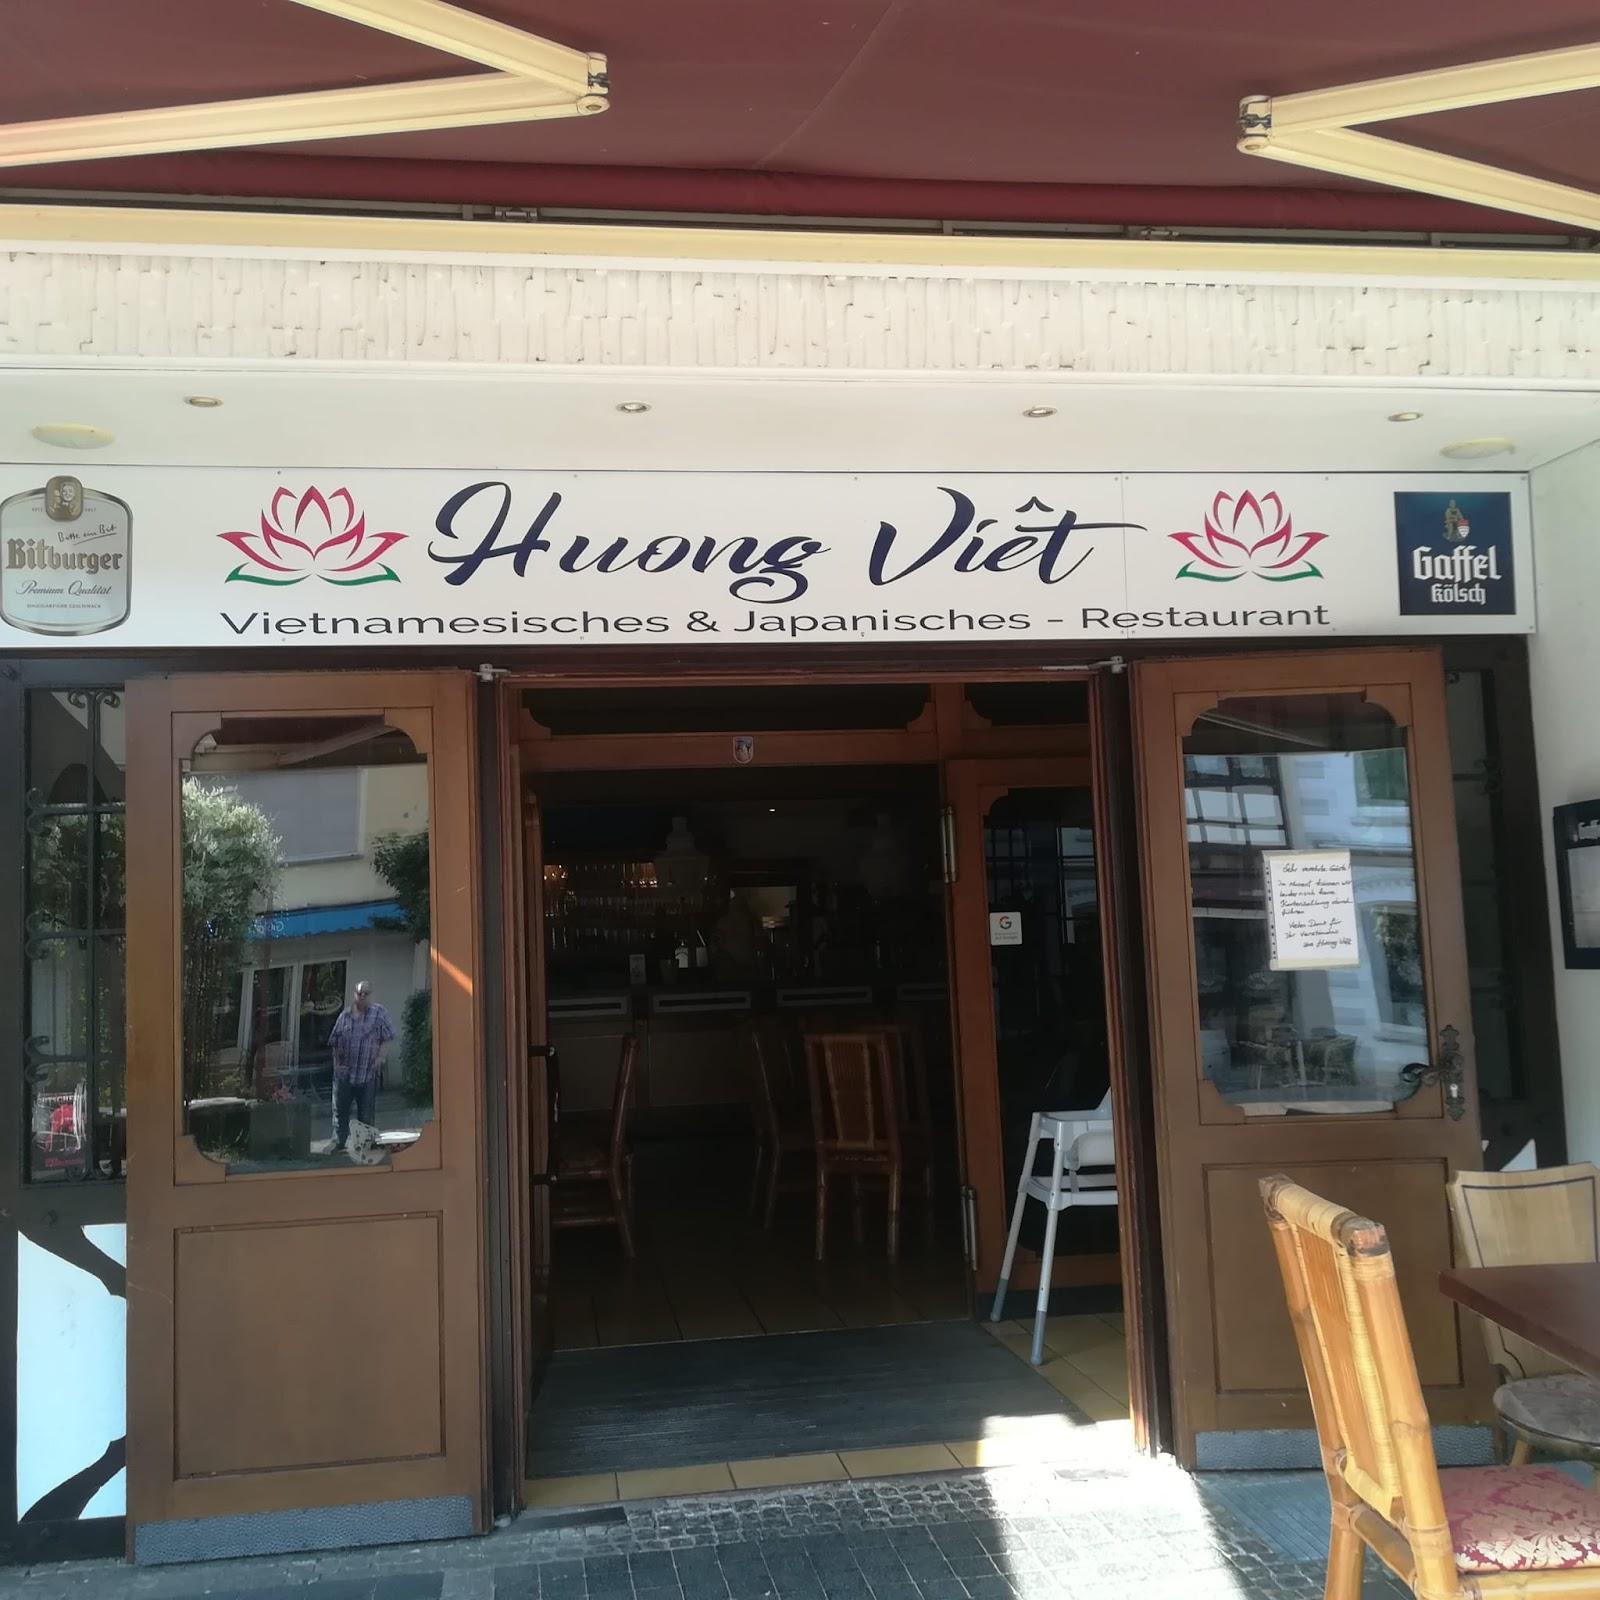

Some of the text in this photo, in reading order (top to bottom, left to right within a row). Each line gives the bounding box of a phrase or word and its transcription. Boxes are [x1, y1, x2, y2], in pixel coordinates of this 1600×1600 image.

[5, 538, 124, 575] Bitburger
[428, 481, 831, 604] Huong
[1412, 545, 1502, 583] Gaffel
[16, 580, 65, 595] Premium
[220, 611, 669, 634] Vietnamesisches
[686, 611, 720, 633] &
[733, 609, 1031, 637] Japanisches
[1081, 605, 1330, 629] Restaurant
